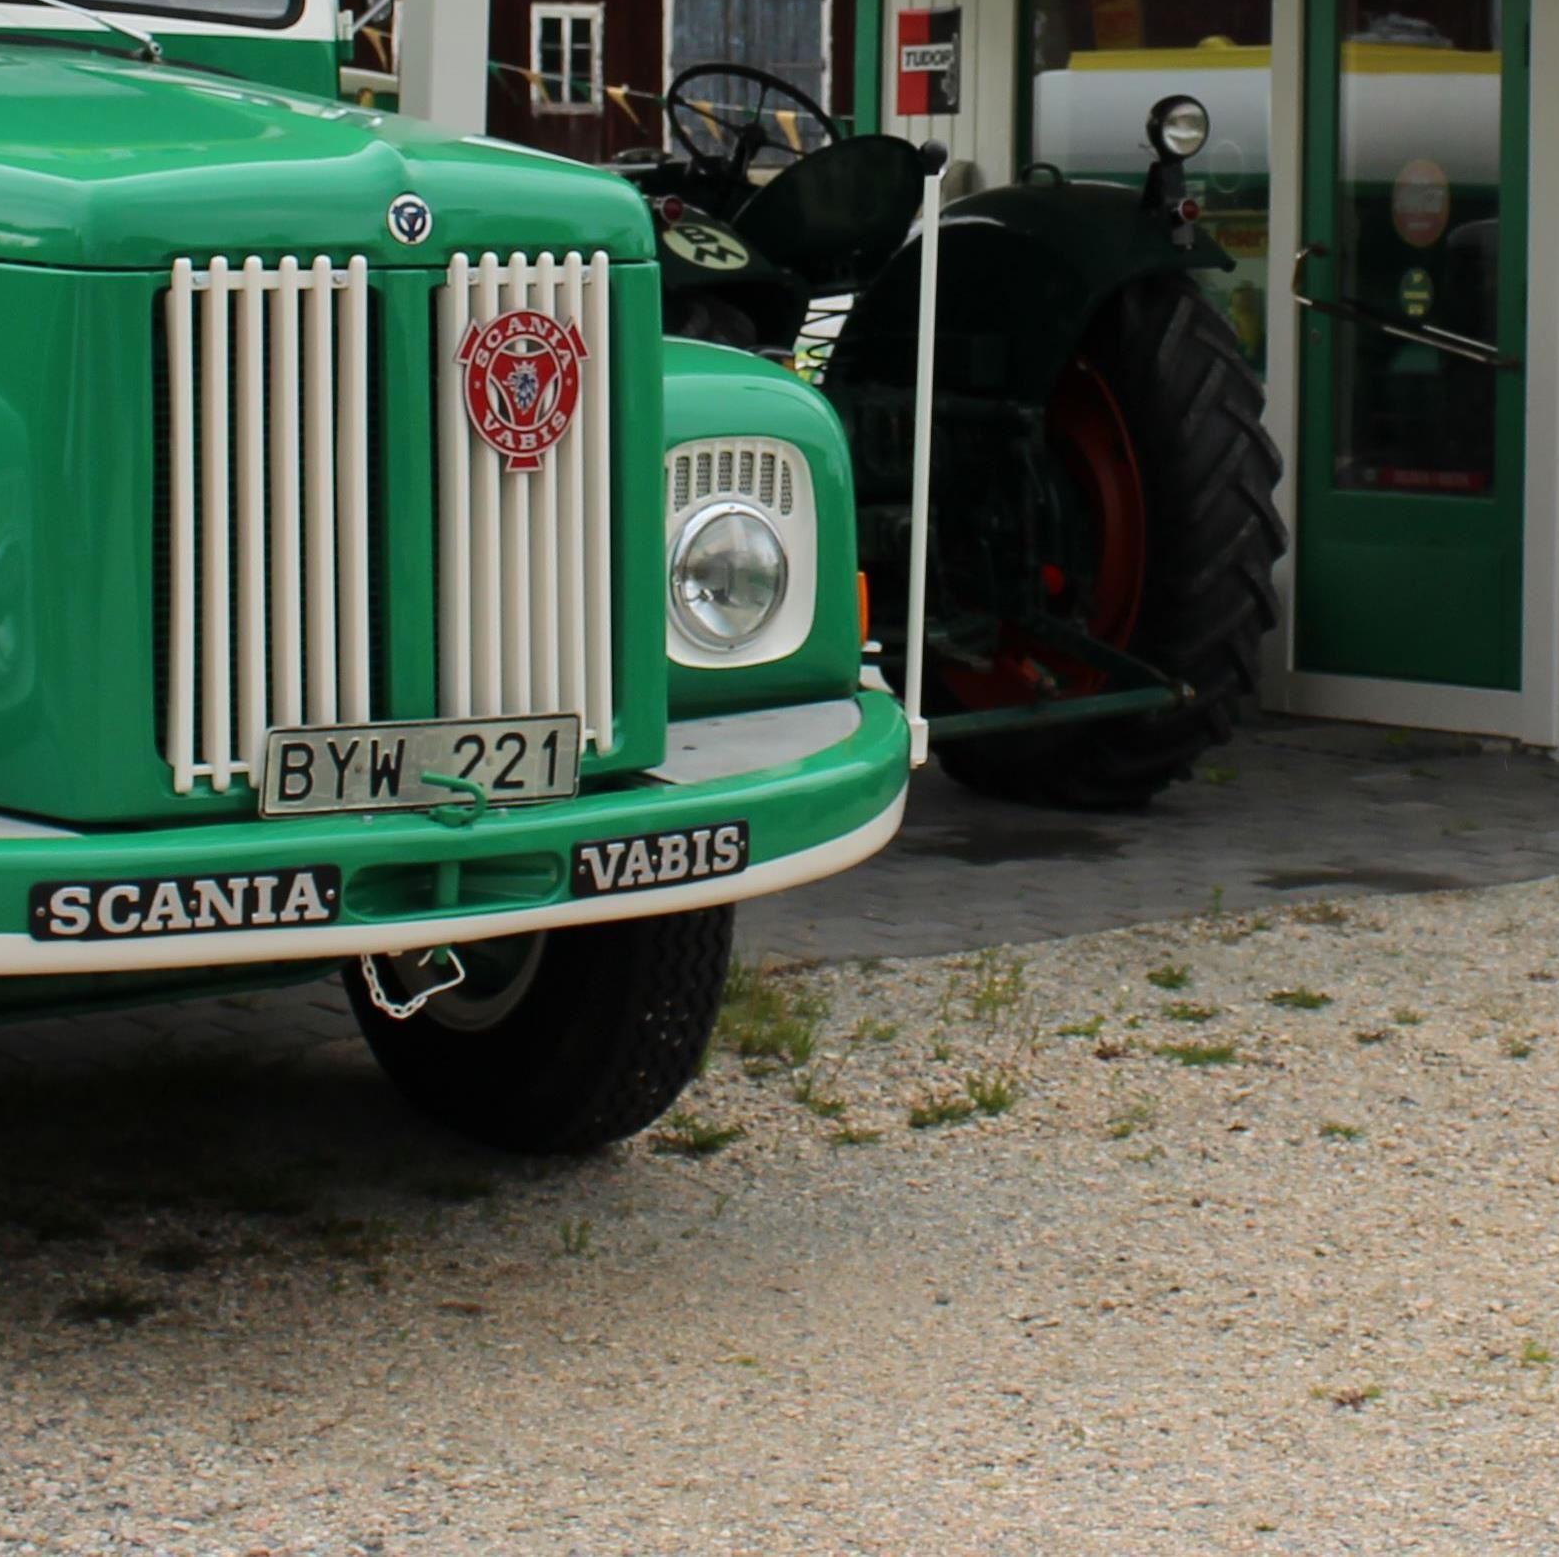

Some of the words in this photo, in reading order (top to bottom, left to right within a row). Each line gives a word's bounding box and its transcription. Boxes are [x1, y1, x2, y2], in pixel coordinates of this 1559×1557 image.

[474, 315, 573, 372] SCANIA
[483, 409, 567, 450] VABIS
[277, 737, 407, 803] BYW
[450, 729, 560, 793] 221
[578, 826, 744, 891] VABIS
[47, 870, 331, 939] SCANIA
